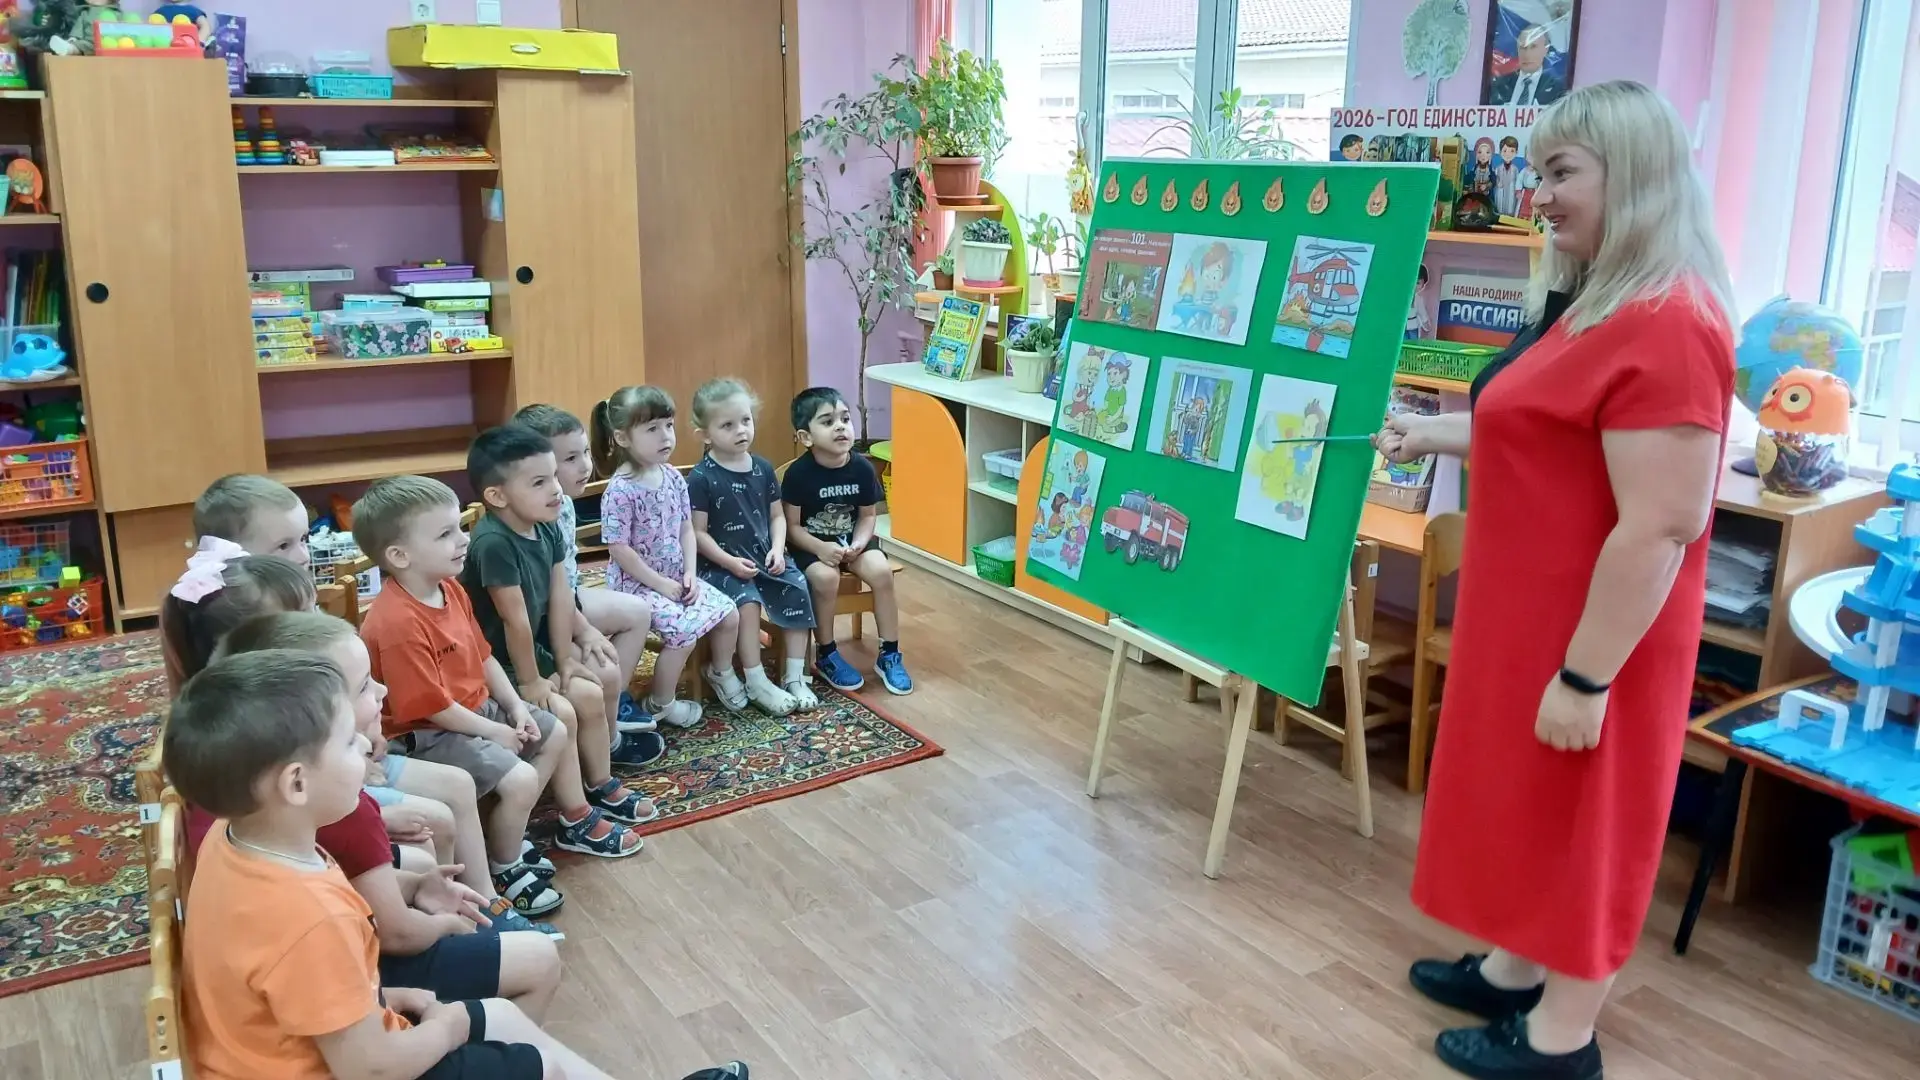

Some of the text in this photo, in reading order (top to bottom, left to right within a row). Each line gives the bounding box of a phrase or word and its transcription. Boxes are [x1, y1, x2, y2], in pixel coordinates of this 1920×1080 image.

[1423, 108, 1508, 129] ЕДИНСТВА
[1514, 108, 1543, 128] НА
[1452, 284, 1480, 298] НАША
[1449, 302, 1525, 329] РОССИЯ!
[819, 483, 860, 499] GRRRR
[143, 808, 149, 820] 1
